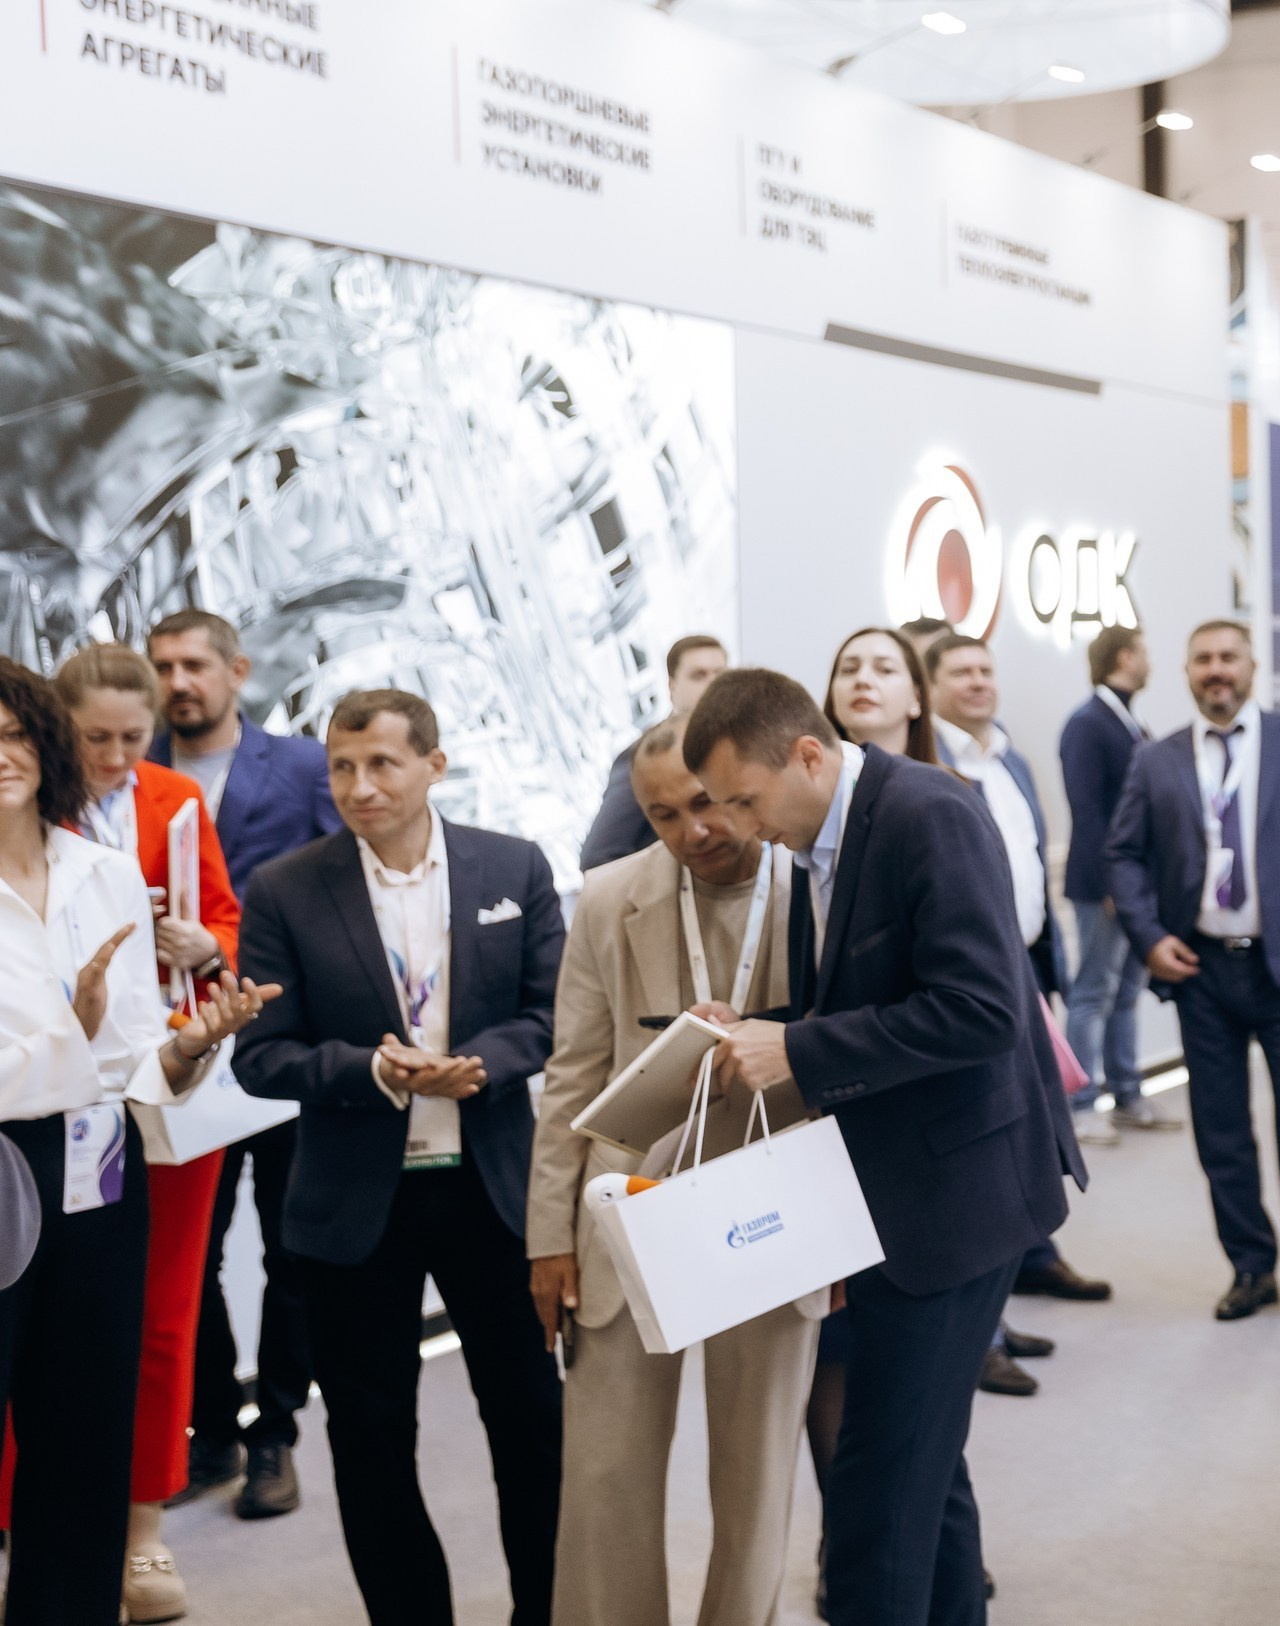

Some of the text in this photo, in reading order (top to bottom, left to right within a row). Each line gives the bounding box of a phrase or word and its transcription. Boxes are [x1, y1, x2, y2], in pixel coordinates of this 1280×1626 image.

[81, 32, 226, 95] АГРЕГАТЫ
[479, 58, 651, 133] ГАЗОПОРШНЕВЫЕ
[482, 101, 651, 170] ЭНЕРГЕТИЧЕСКИЕ
[483, 142, 602, 194] УСТАНОВКИ
[760, 180, 876, 229] ОБОРУДОВАНИЕ
[1026, 532, 1139, 640] ОДК
